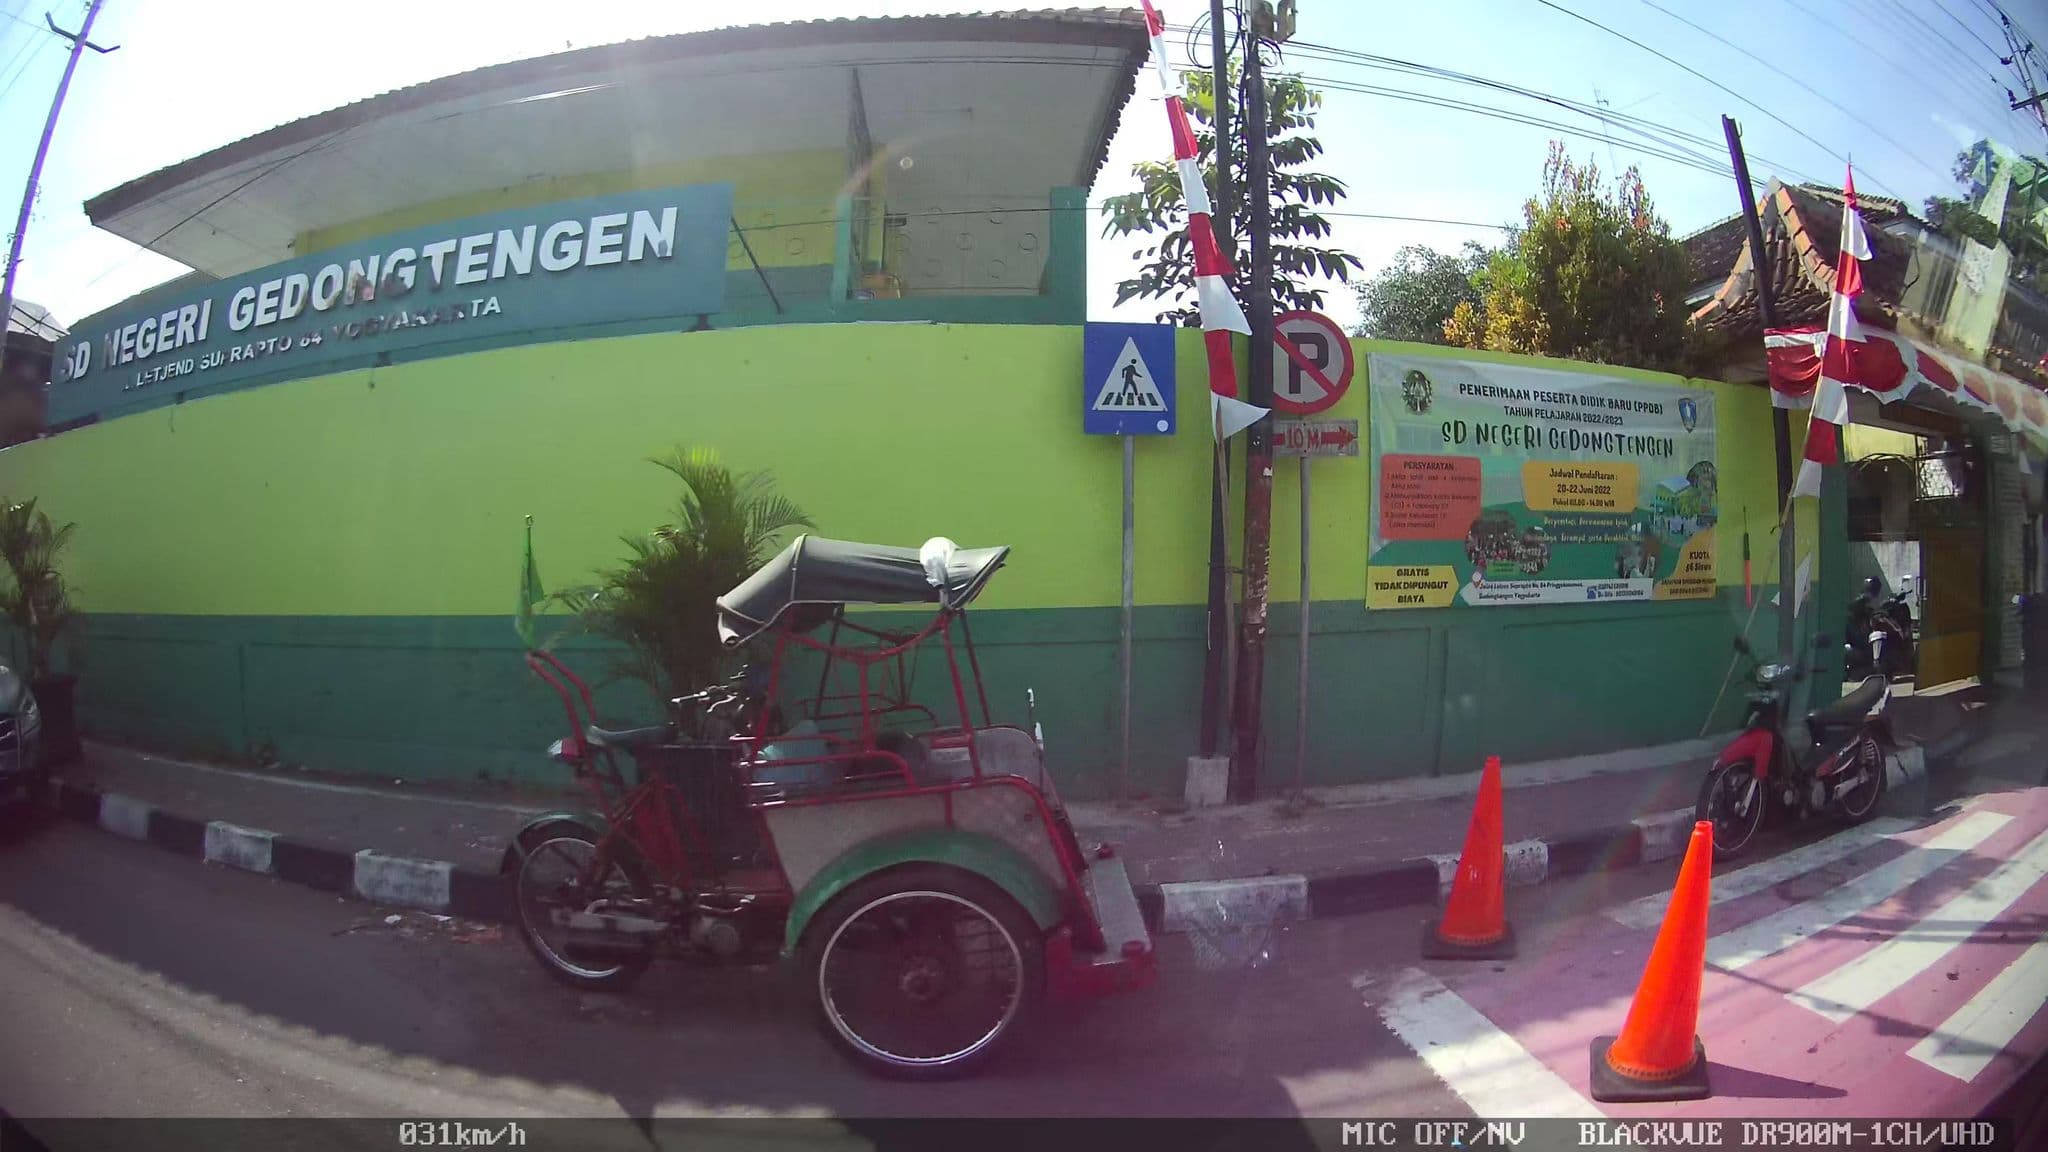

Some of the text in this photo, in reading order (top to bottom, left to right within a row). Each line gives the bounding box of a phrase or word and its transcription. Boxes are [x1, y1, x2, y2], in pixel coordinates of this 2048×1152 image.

[103, 299, 212, 368] NEGERI
[229, 207, 678, 332] GEDONGTENGEN
[136, 358, 194, 387] LETJEND
[1288, 332, 1329, 394] P
[1459, 383, 1663, 415] PENERIMAAN PESERTA DIDIK BARU (PPDB)
[1504, 405, 1623, 425] TAHUN PELAJARAN 2022/2023
[1286, 429, 1322, 449] 10 M
[1441, 420, 1467, 444] SD
[1549, 468, 1574, 478] Jadwal
[1575, 469, 1614, 480] Pendaftaran
[1557, 484, 1611, 495] 20-22 Juni 2022
[1396, 568, 1430, 577] GRATIS
[1374, 580, 1448, 590] TIDAK DIPUNGUT
[1397, 595, 1425, 603] BIAYA
